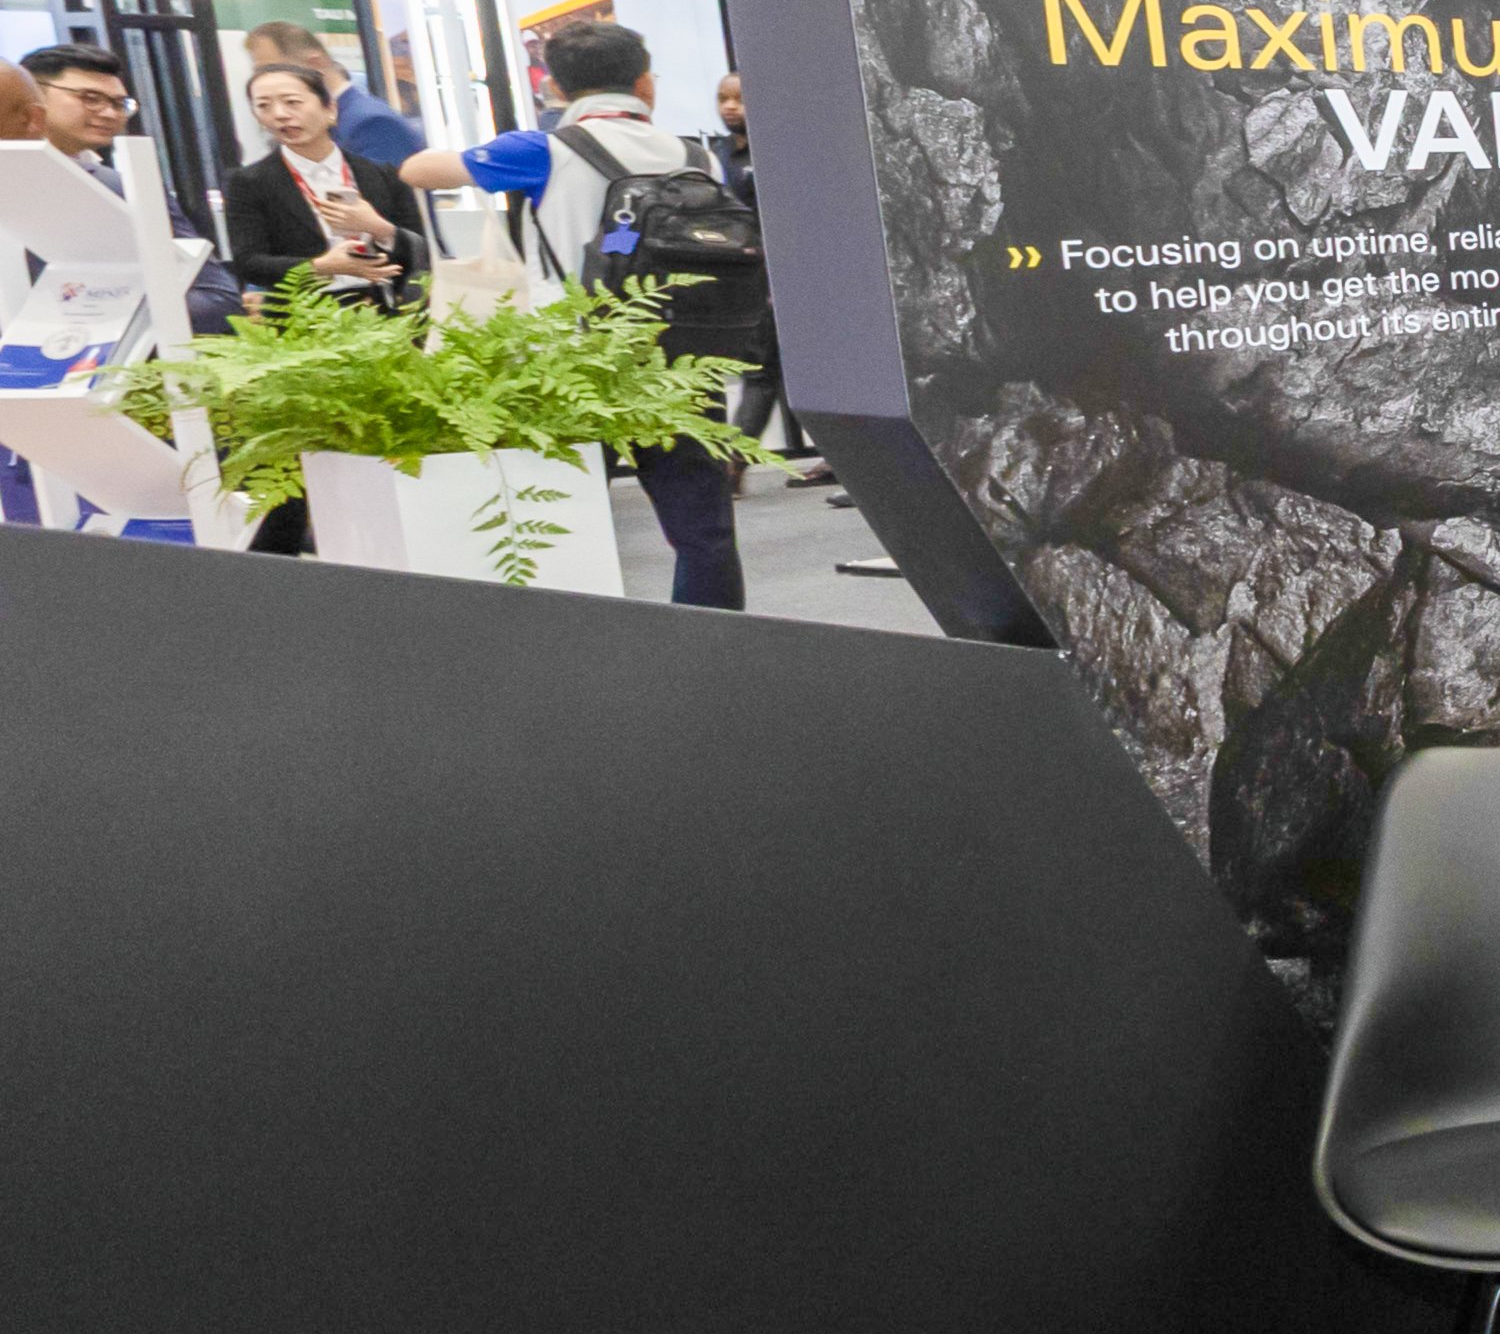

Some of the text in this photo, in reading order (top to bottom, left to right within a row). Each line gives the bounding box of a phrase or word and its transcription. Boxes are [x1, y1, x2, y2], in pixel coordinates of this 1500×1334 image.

[1060, 235, 1242, 270] Focusing
[1253, 237, 1300, 261] on
[1313, 228, 1438, 263] uptime,
[1095, 288, 1138, 313] to
[1150, 278, 1232, 313] help
[1246, 278, 1310, 310] you
[1322, 272, 1377, 305] get
[1389, 267, 1440, 295] the
[1165, 313, 1371, 353] throughout
[1381, 308, 1421, 336] its
